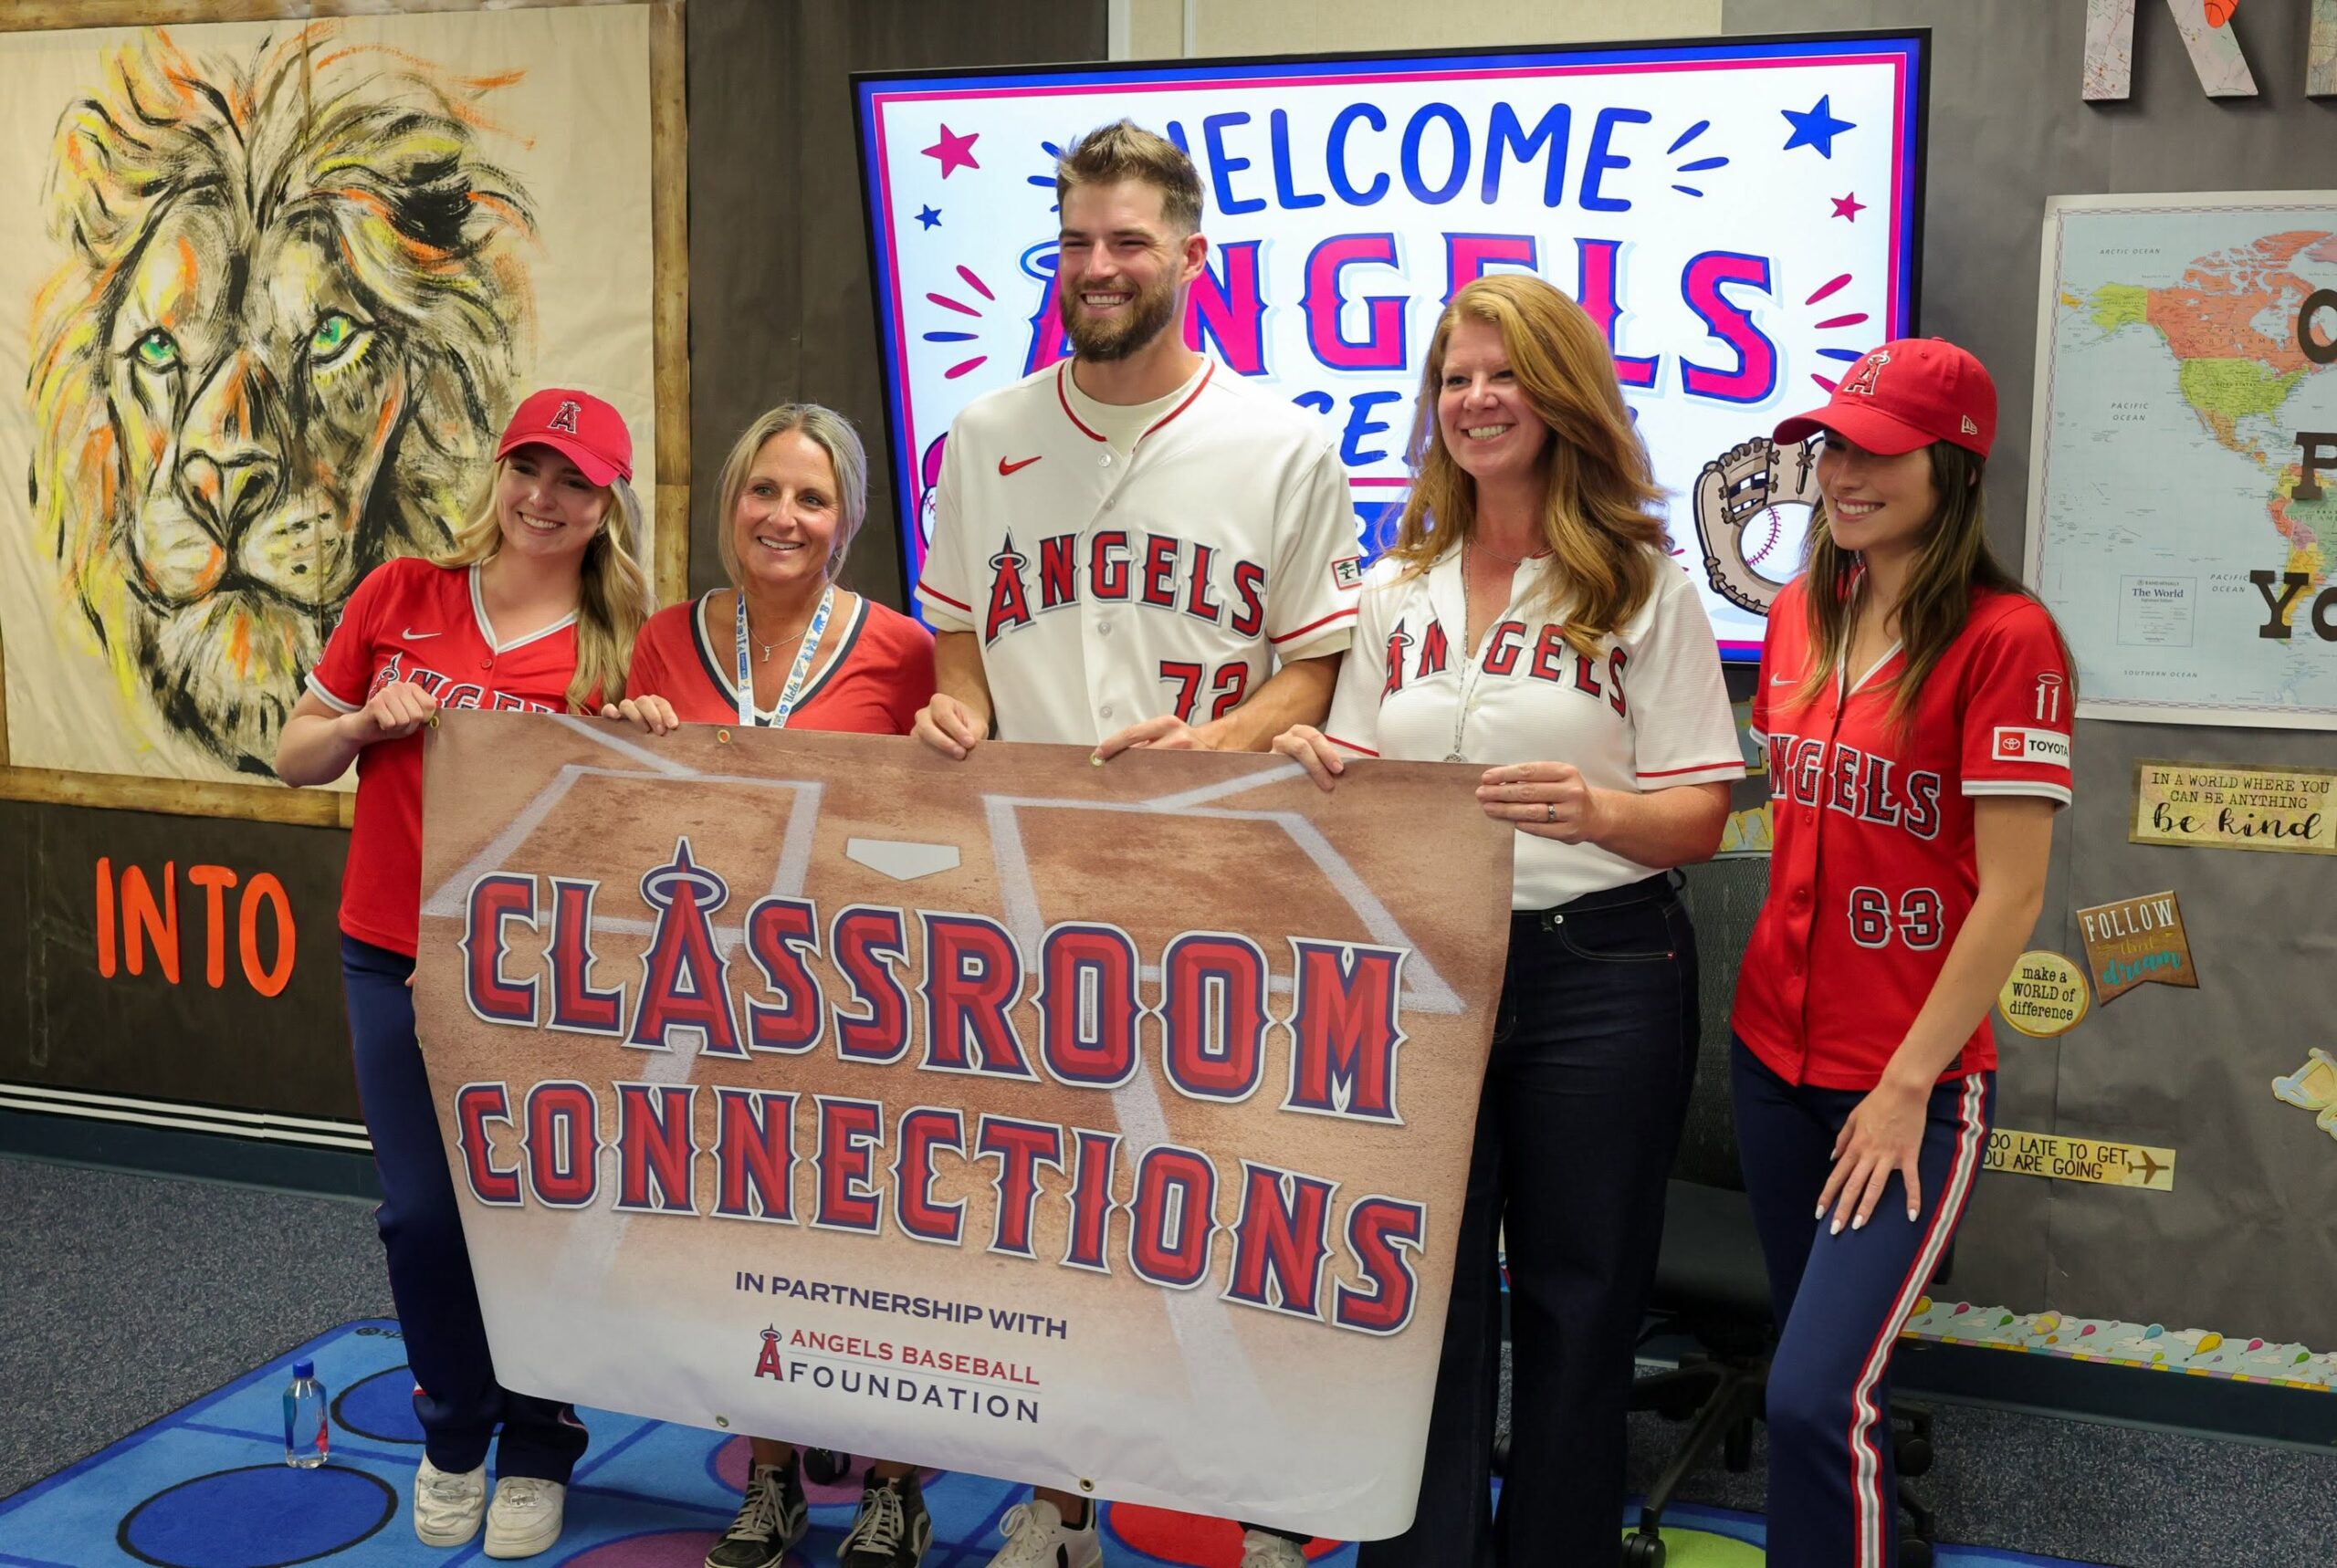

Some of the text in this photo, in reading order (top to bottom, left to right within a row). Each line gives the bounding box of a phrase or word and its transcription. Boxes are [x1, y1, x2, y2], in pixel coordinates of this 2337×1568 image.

[1167, 100, 1652, 216] ELCOME
[548, 401, 579, 434] A
[2111, 402, 2149, 410] PACIFIC
[2112, 414, 2146, 423] OCEAN
[984, 526, 1268, 650] ANGELS
[2132, 588, 2185, 598] The World
[2028, 739, 2069, 756] TOYOTA
[1769, 734, 1940, 840] NGELS
[2152, 772, 2330, 794] IN A WORLD WHERE YOU
[2170, 790, 2308, 809] CAN BE ANYTHING
[2152, 801, 2322, 840] be kind
[96, 857, 296, 998] INTO
[1849, 887, 1944, 950] 63
[2084, 899, 2175, 942] FOLLOW
[459, 835, 1410, 1124] CLASSROOM
[2022, 967, 2067, 983] make a
[2102, 950, 2181, 986] dream
[2009, 1000, 2073, 1020] difference
[2012, 982, 2076, 1002] WORLD of
[1984, 1151, 2103, 1180] OU ARE GOING
[1988, 1133, 2129, 1166] OO LATE TO GET
[457, 1080, 1426, 1335] CONNECTIONS
[736, 1271, 1067, 1340] IN PARTNERSHIP WITH
[790, 1329, 1040, 1385] ANGELS BASEBALL
[790, 1362, 1039, 1424] FOUNDATION
